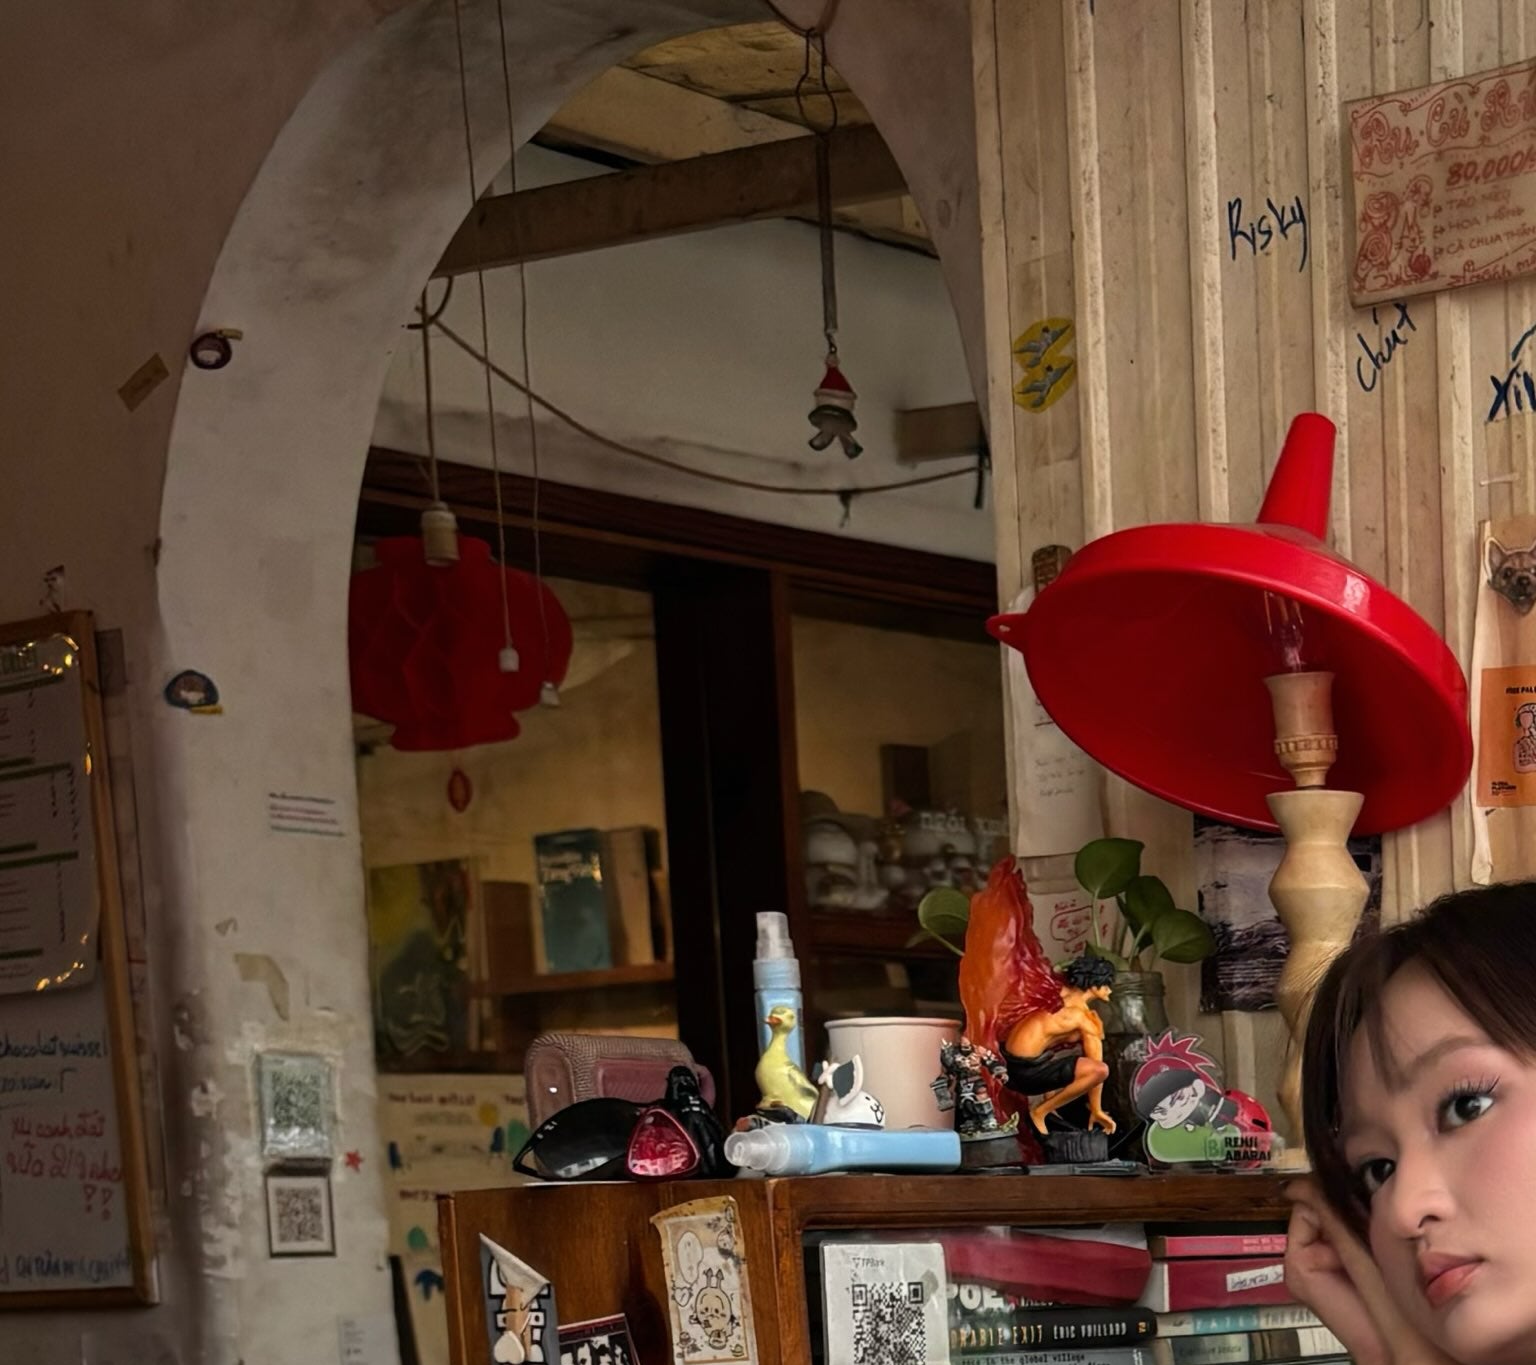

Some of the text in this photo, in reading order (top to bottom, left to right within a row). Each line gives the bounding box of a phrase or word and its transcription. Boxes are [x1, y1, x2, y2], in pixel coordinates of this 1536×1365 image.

[1228, 195, 1309, 273] Risky
[1012, 1324, 1044, 1345] EXIT
[1052, 1352, 1086, 1365] village
